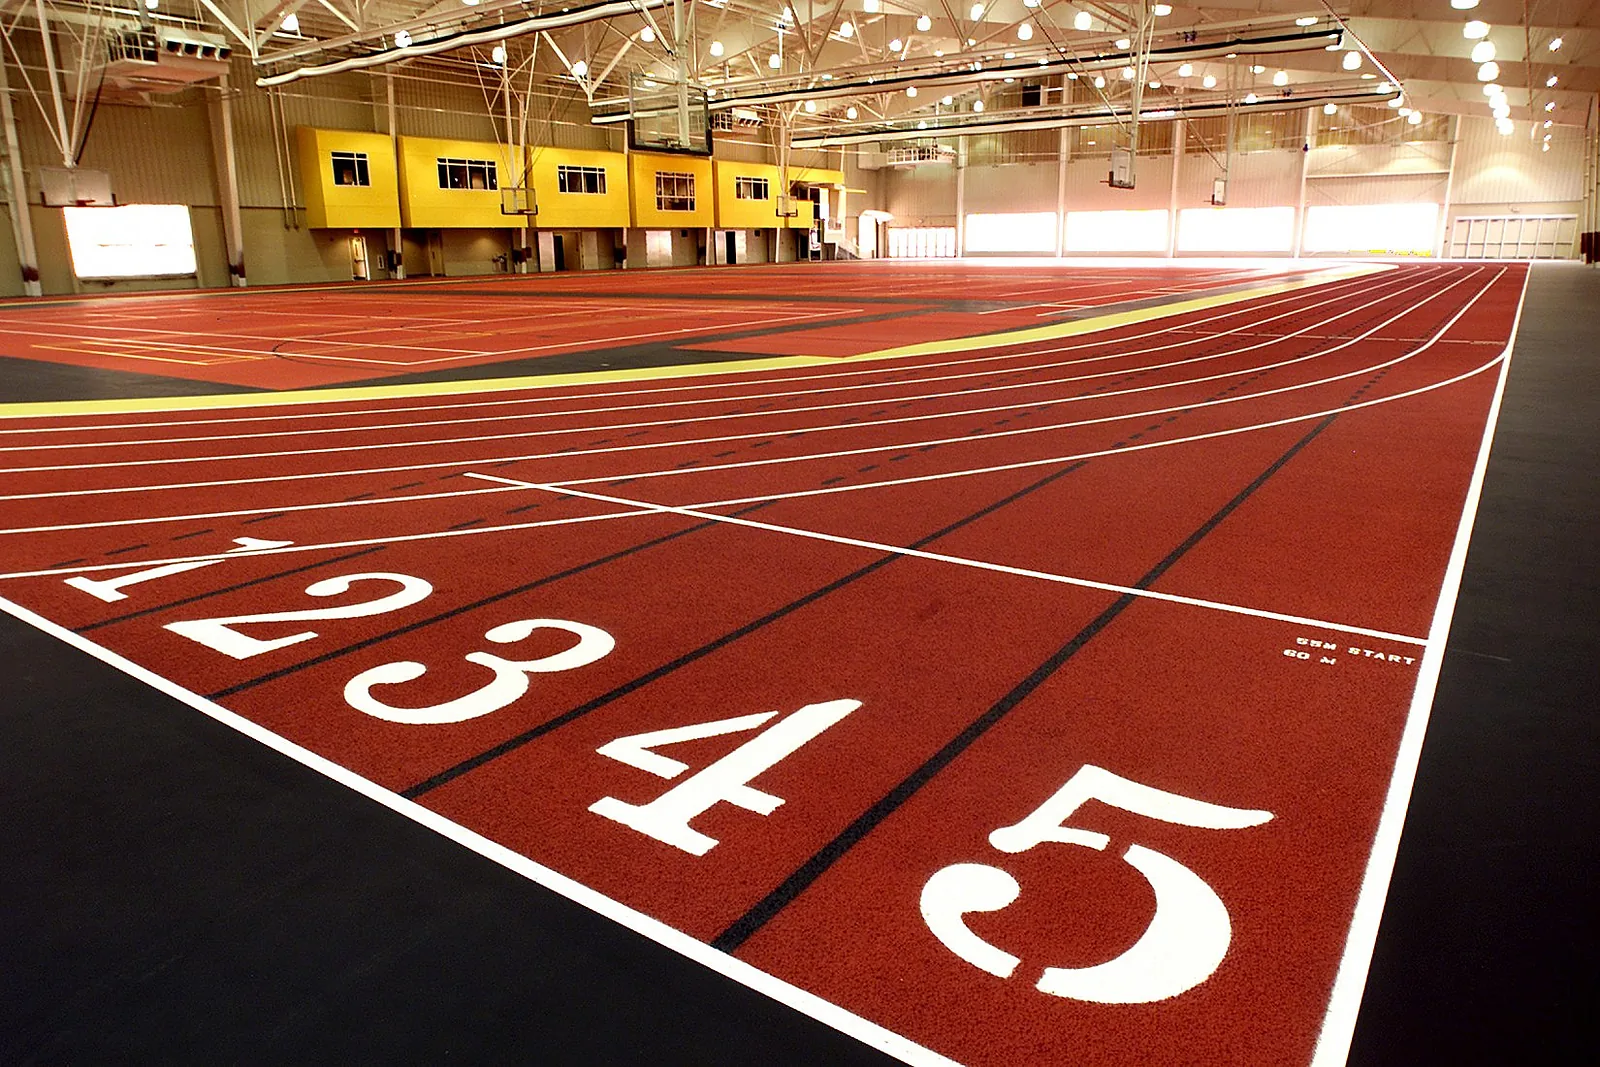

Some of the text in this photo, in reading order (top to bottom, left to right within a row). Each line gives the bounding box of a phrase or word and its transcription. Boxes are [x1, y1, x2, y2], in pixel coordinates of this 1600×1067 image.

[64, 537, 294, 603] 1
[163, 572, 434, 660] 2
[1283, 649, 1337, 665] 60 M
[1347, 647, 1416, 665] START
[343, 618, 616, 725] 3
[587, 698, 863, 857] 4
[919, 763, 1276, 1006] 5
